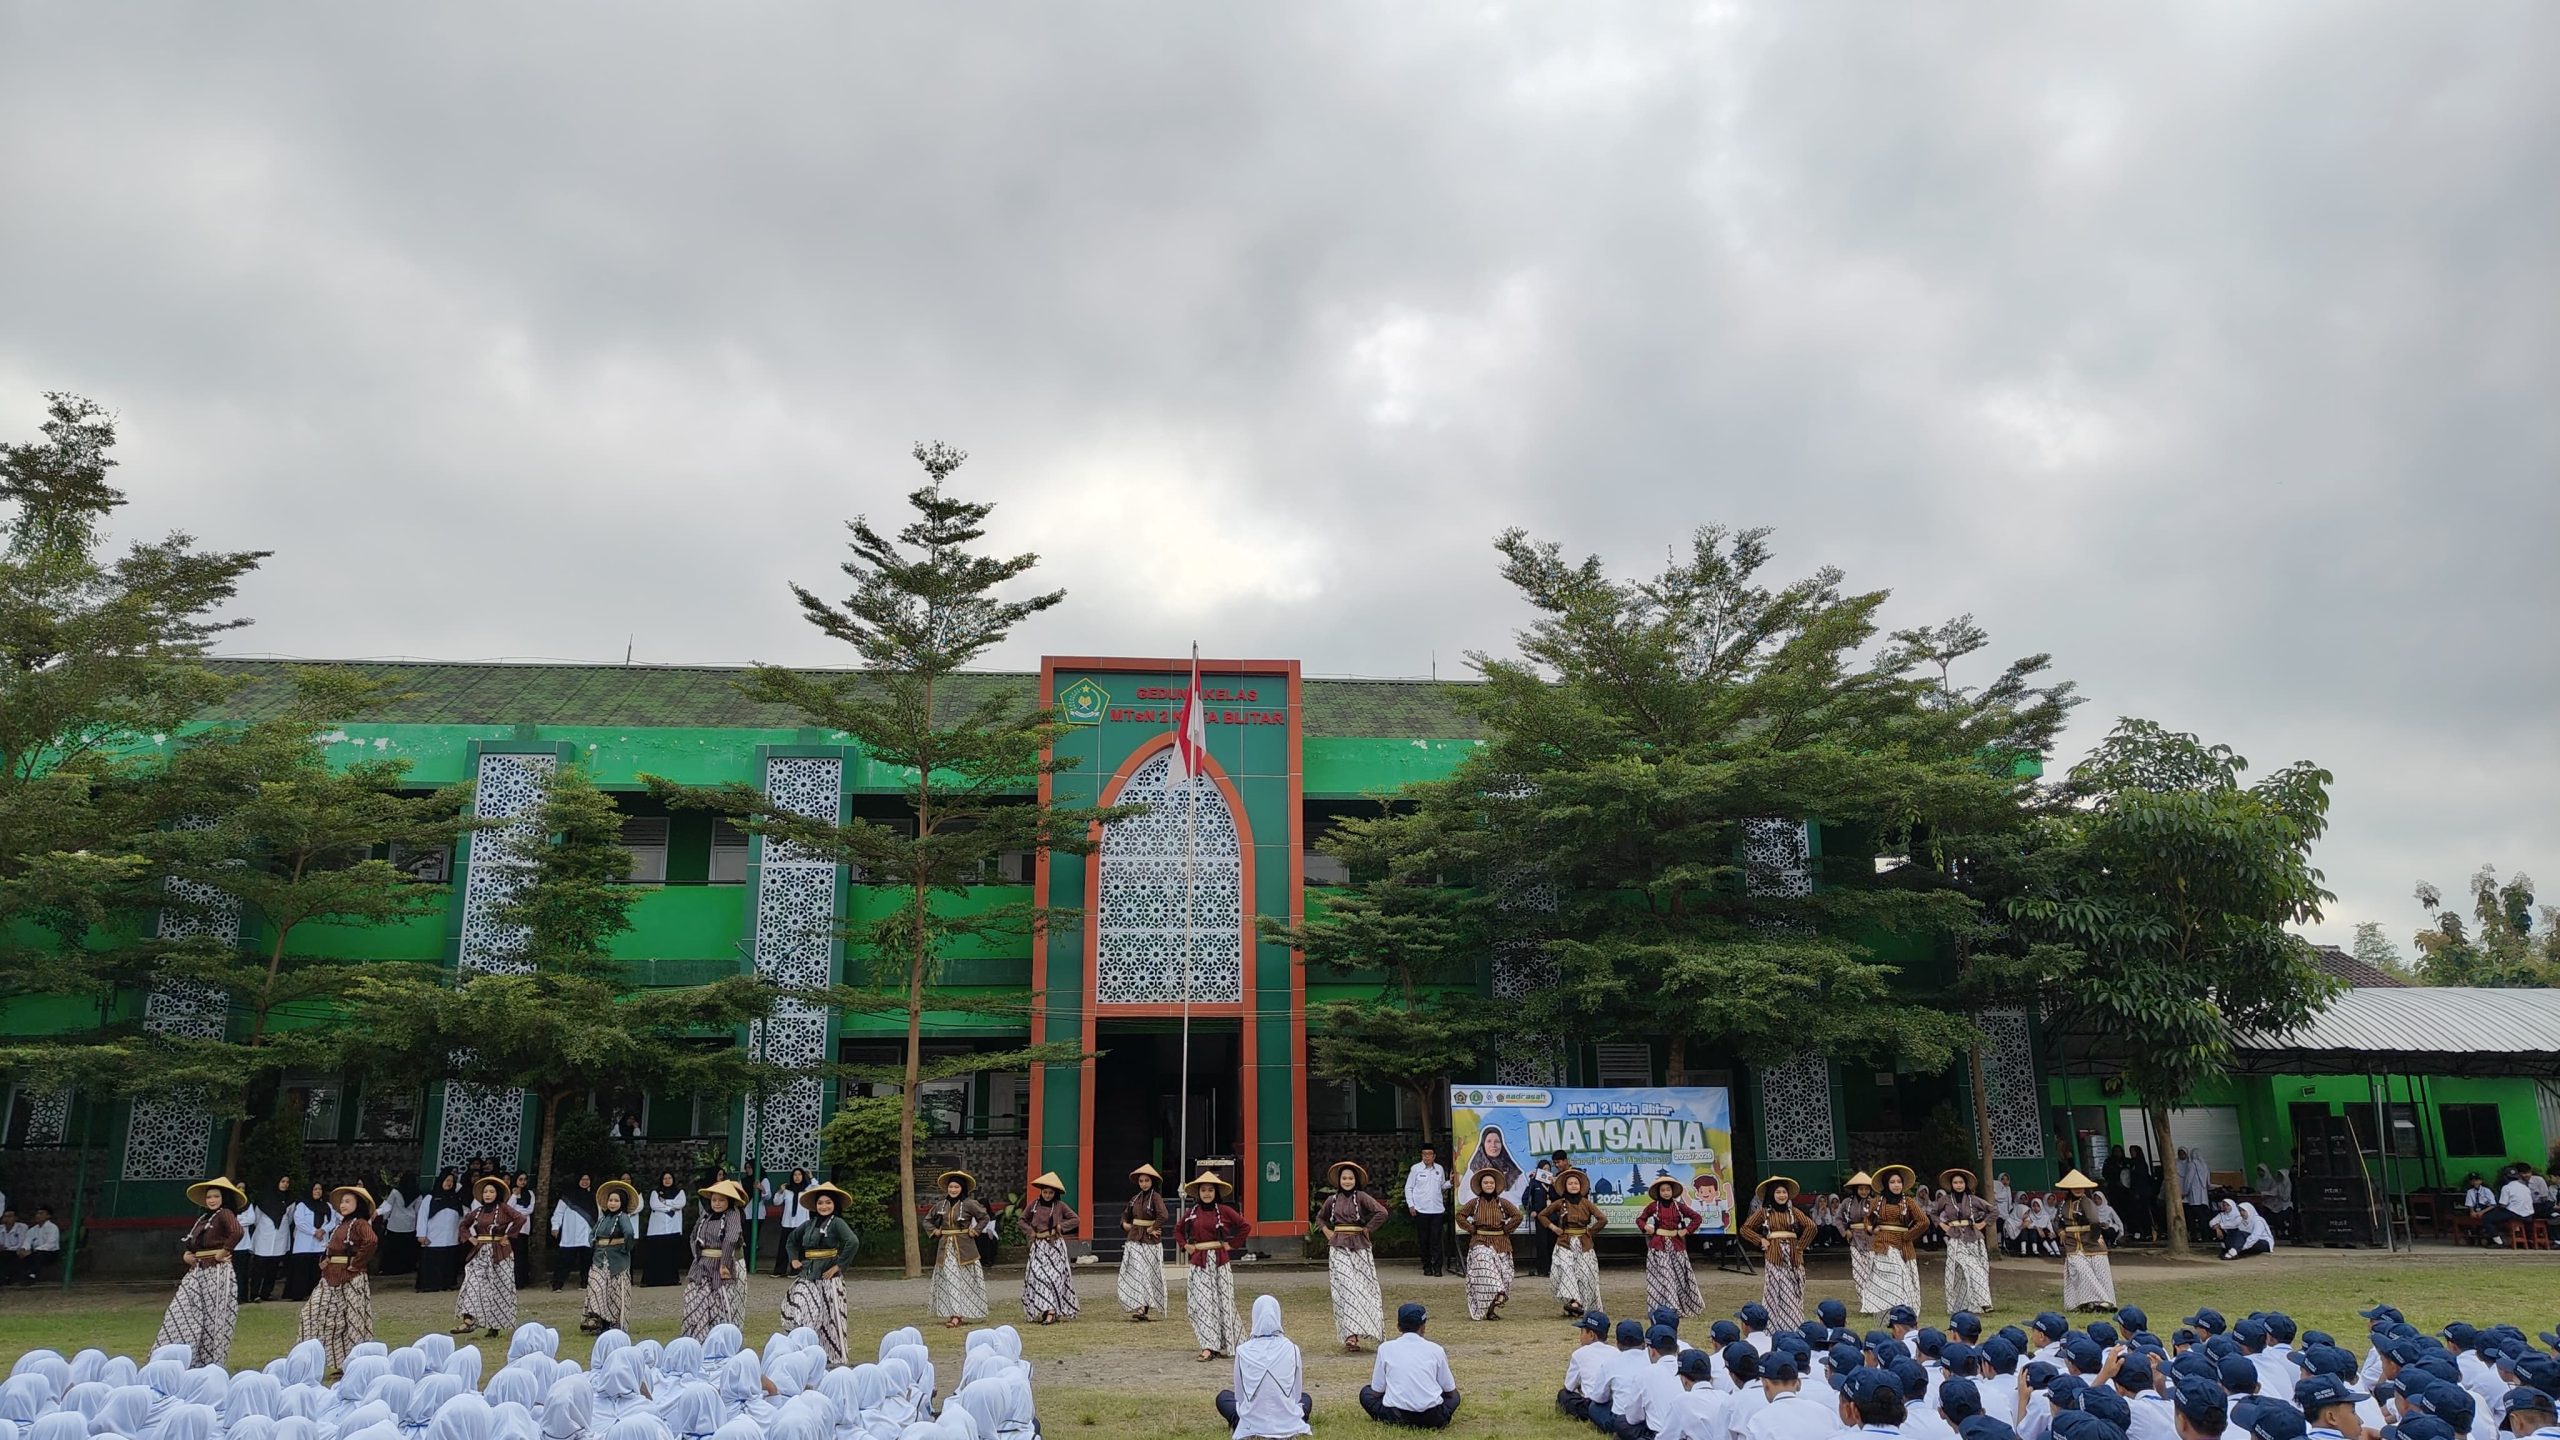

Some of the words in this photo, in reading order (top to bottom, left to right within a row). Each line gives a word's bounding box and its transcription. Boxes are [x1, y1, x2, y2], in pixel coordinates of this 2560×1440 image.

[1137, 687, 1188, 700] GEDUN
[1204, 688, 1258, 702] KELAS
[1109, 708, 1155, 723] MTsN
[1159, 710, 1169, 723] 2
[1224, 711, 1285, 725] BLITAR
[1567, 1103, 1598, 1115] MTsN
[1601, 1104, 1609, 1115] 2
[1612, 1103, 1638, 1115] Kota
[1641, 1104, 1674, 1116] Blitar
[1529, 1117, 1706, 1155] MATSAMA
[1674, 1151, 1713, 1161] 2025/2026
[1596, 1193, 1624, 1205] 2025
